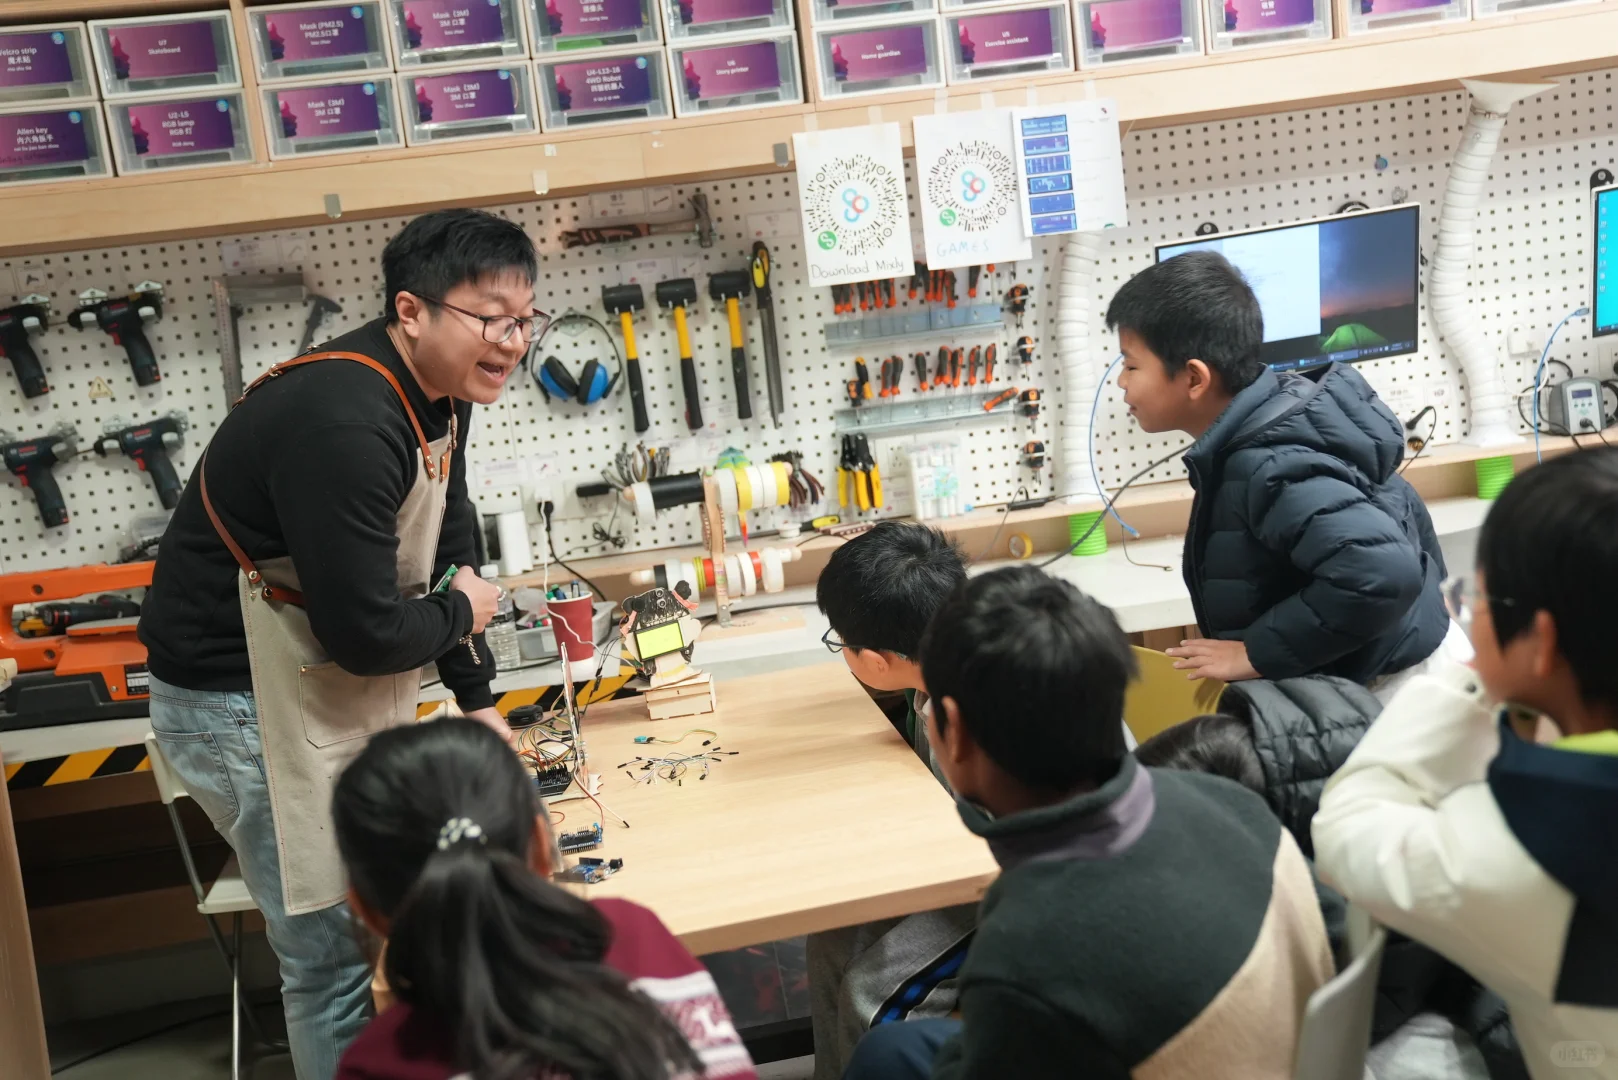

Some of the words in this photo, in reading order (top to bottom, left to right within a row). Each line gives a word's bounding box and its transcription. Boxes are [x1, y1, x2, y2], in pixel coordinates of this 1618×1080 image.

[432, 11, 450, 19] Mask
[299, 22, 317, 30] Mask
[877, 50, 901, 59] guardian
[602, 74, 622, 83] Robot
[443, 85, 461, 93] Mask
[307, 101, 325, 109] Mask
[16, 128, 35, 136] Allen
[35, 126, 48, 135] key
[169, 128, 184, 136] RGB
[936, 239, 990, 257] GAMES
[811, 259, 869, 279] Download
[875, 256, 904, 273] Mixly
